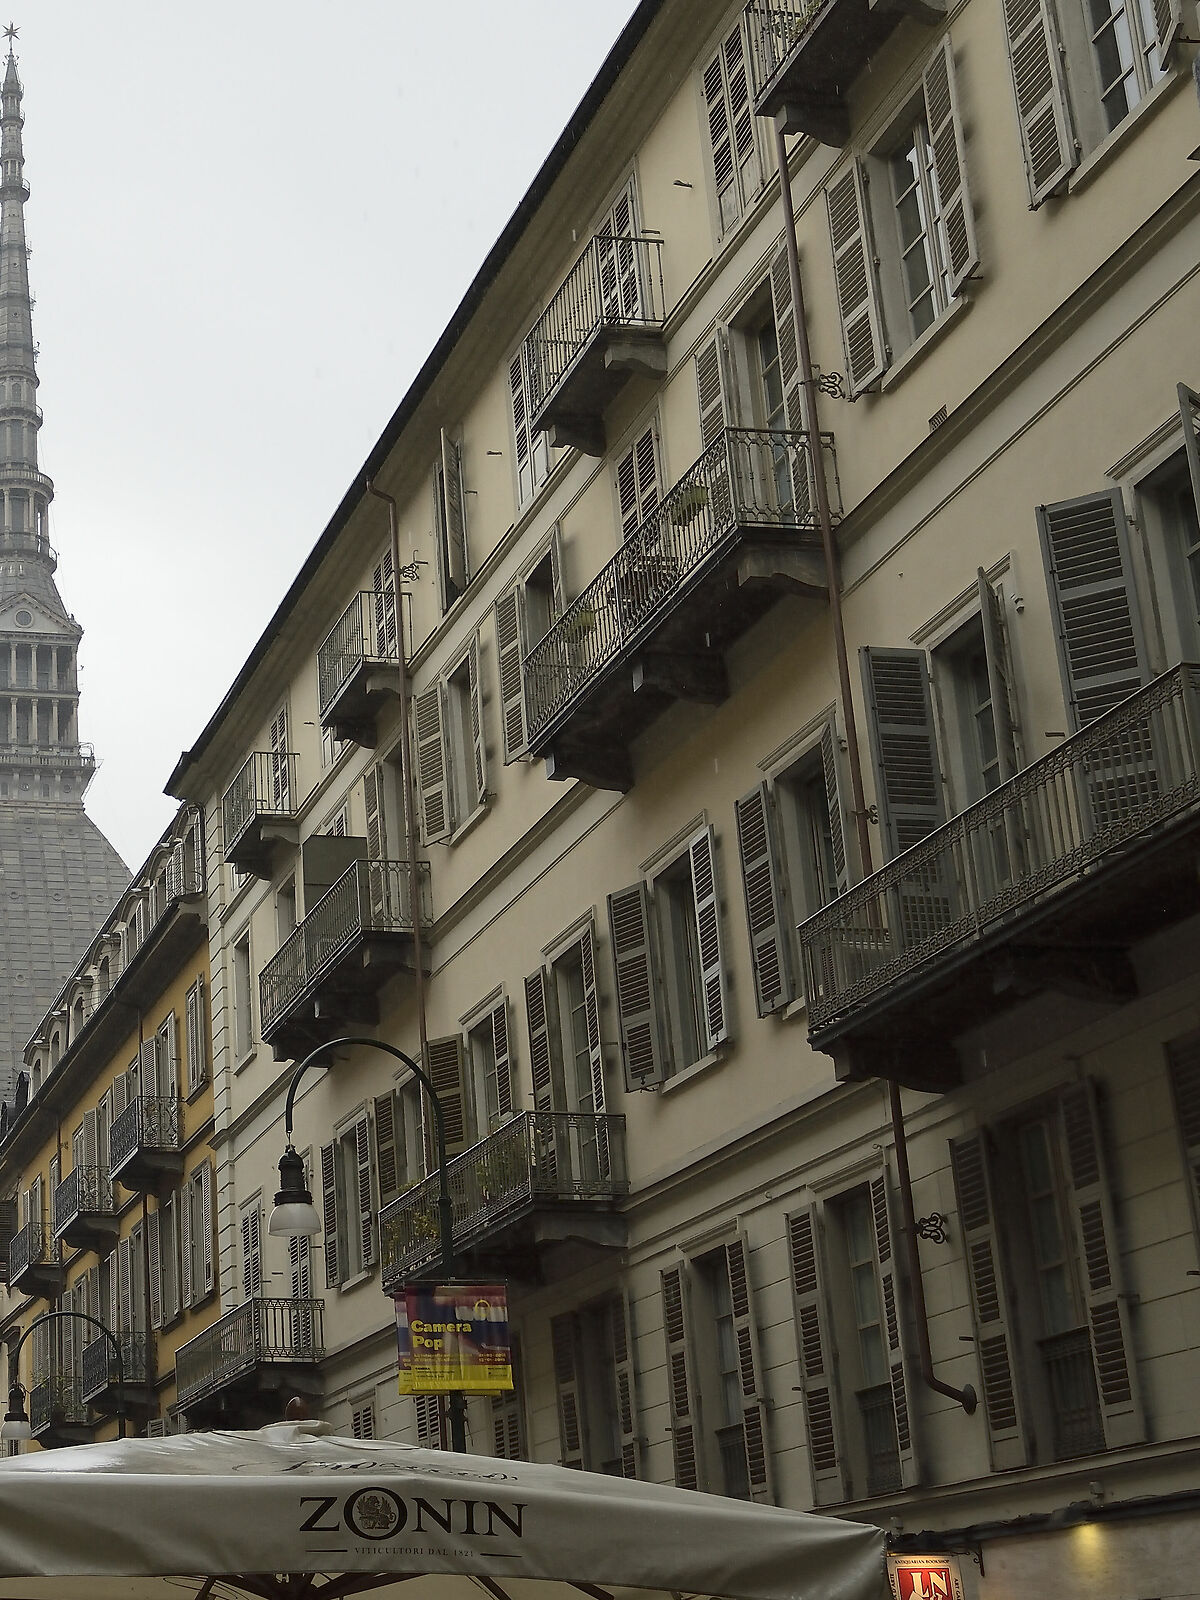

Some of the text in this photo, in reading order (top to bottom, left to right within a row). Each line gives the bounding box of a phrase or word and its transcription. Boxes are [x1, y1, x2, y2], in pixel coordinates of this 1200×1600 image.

[411, 1320, 472, 1333] Camera
[412, 1336, 443, 1350] Pop
[299, 1486, 528, 1541] ZONIN
[355, 1547, 473, 1557] VITICULTORI DAL 1821
[910, 1571, 948, 1598] LN
